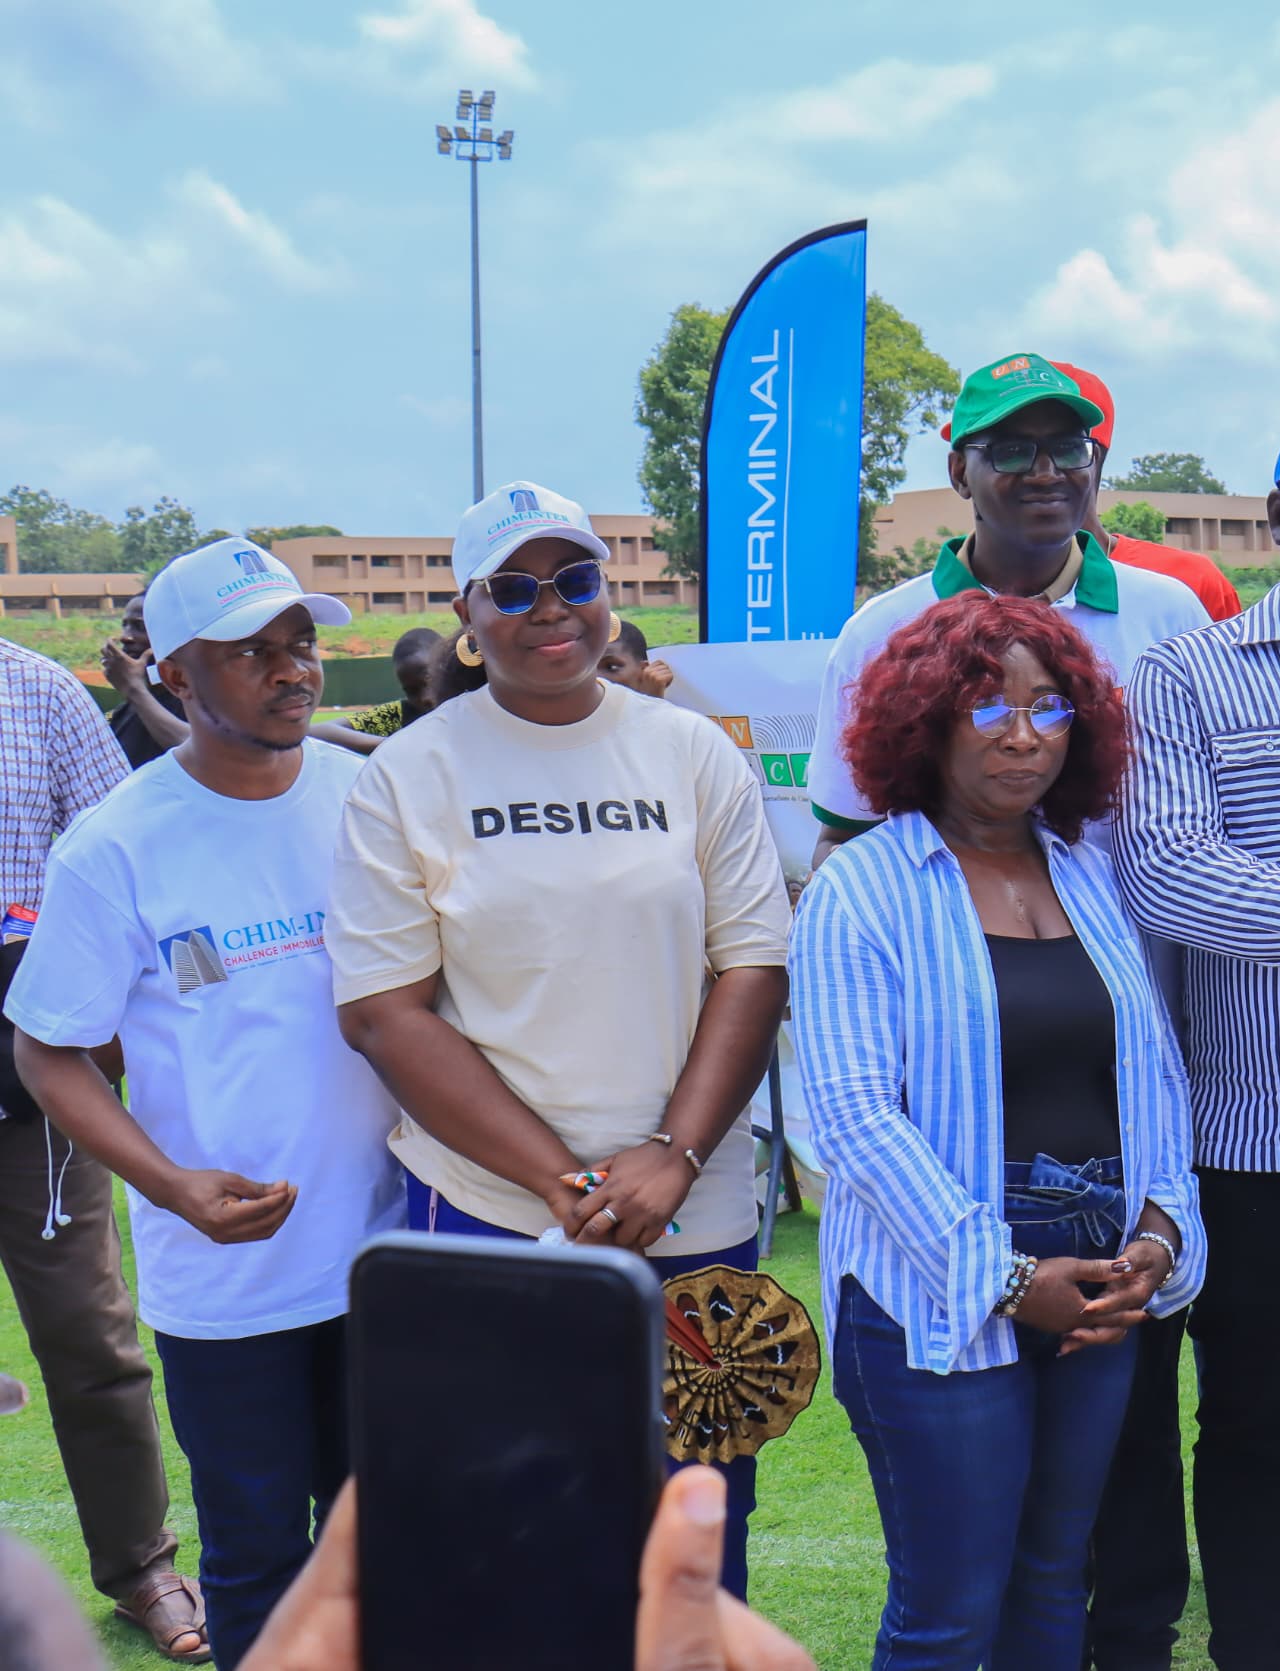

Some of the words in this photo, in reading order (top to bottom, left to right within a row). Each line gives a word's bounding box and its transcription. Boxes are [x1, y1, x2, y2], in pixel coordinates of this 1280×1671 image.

[745, 329, 780, 642] TERMINAL
[471, 798, 670, 839] DESIGN
[223, 946, 279, 967] CHALLENGE
